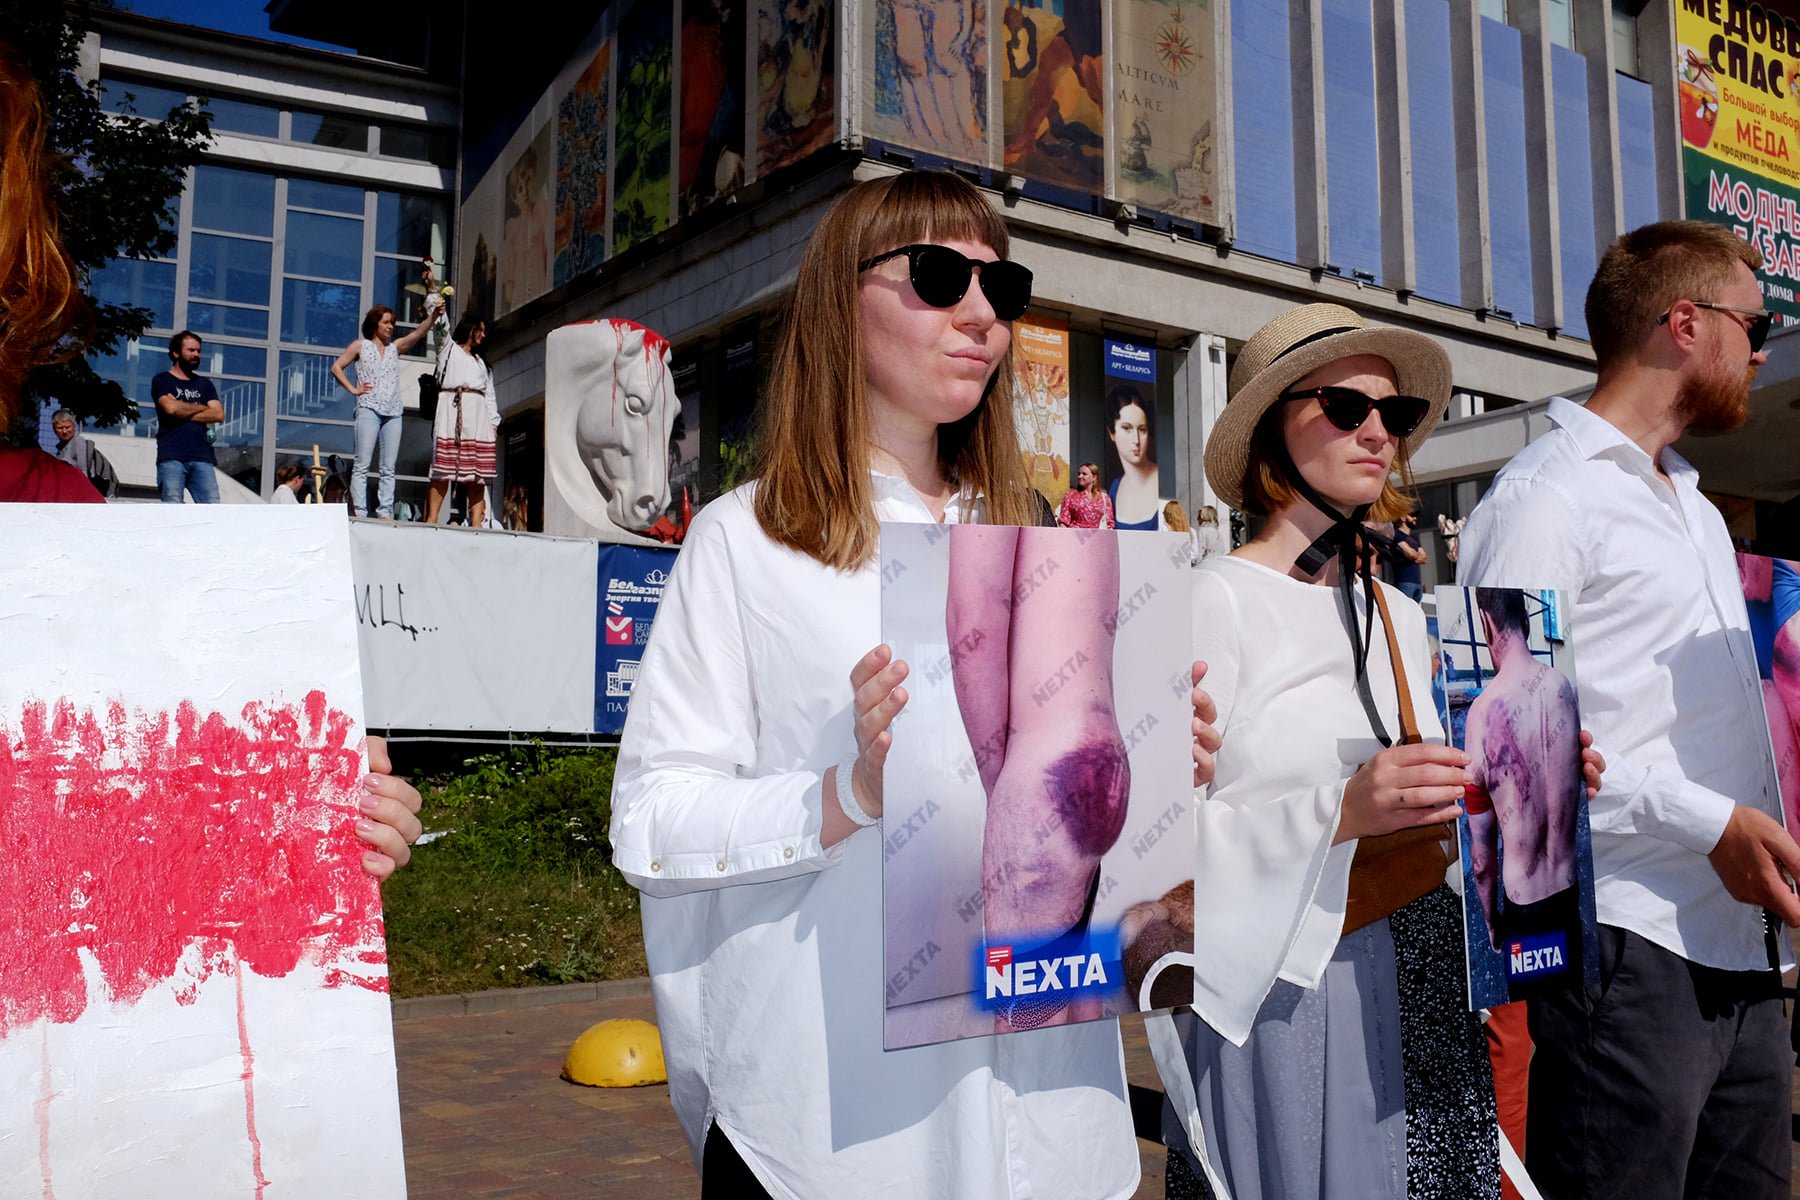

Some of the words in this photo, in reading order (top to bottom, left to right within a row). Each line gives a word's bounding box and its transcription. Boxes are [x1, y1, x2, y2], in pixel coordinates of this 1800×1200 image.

[1708, 34, 1784, 99] СПАС
[1723, 87, 1767, 118] Большой
[1769, 110, 1800, 133] выбор
[1712, 140, 1719, 150] и
[1720, 144, 1759, 165] продуктов
[1736, 117, 1789, 162] МЁДА
[1767, 282, 1794, 303] дома
[1031, 650, 1090, 708] NEXTA
[1131, 801, 1187, 861] NEXTA
[986, 953, 1108, 999] NEXTA
[1511, 945, 1563, 974] NEXTA
